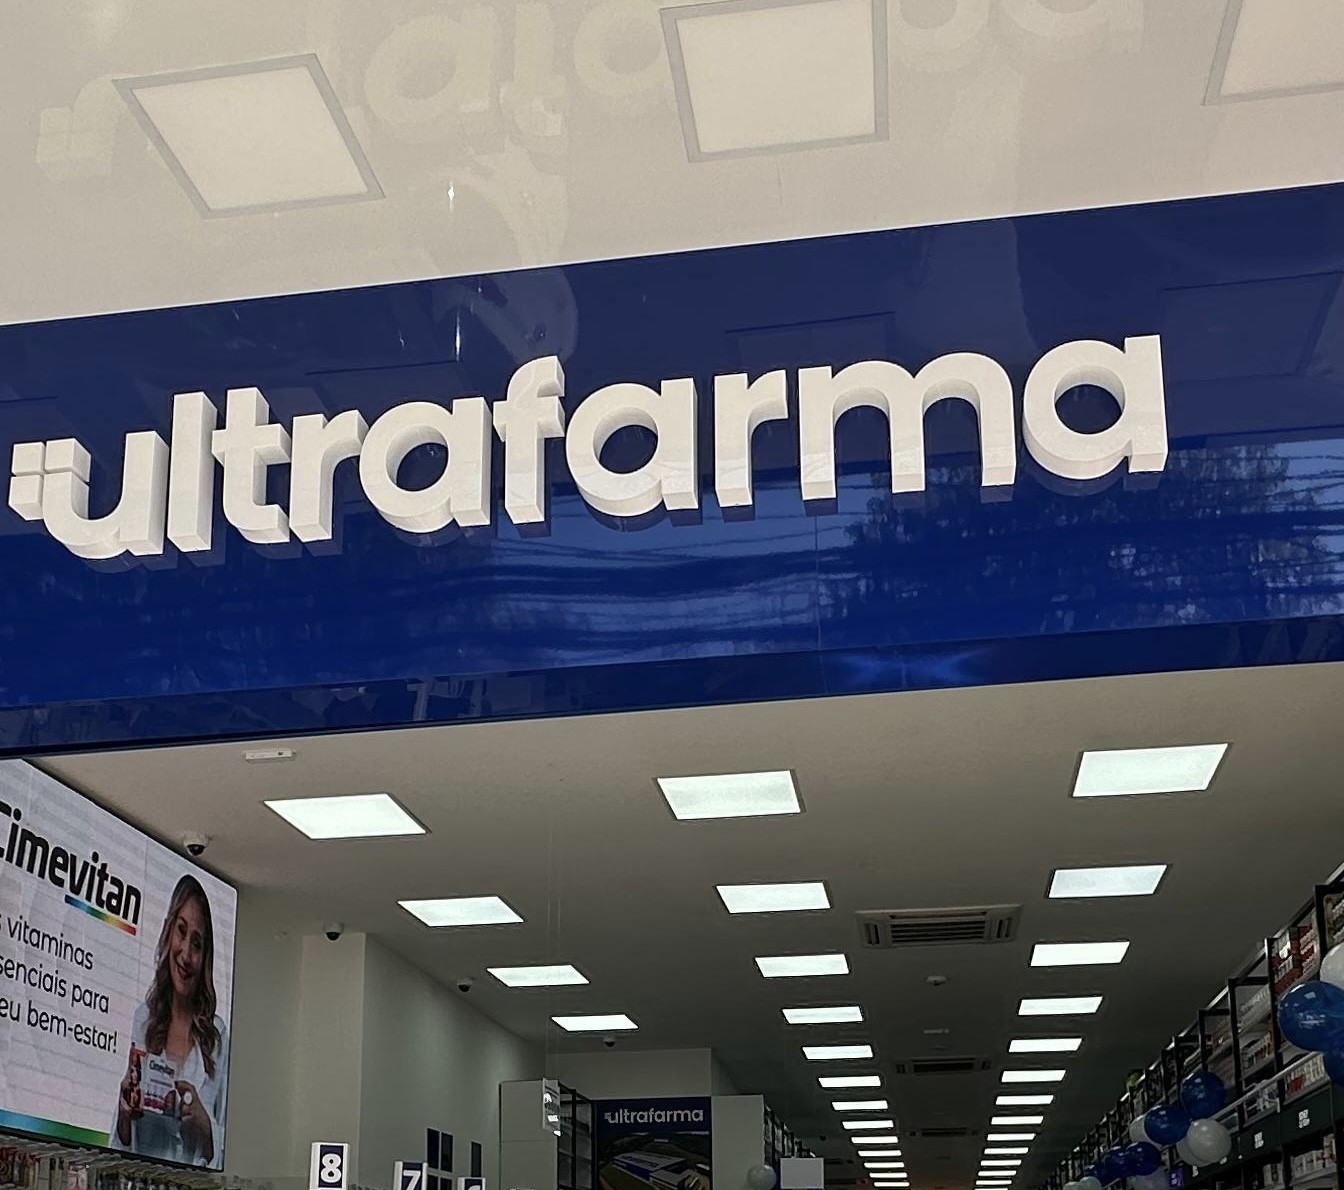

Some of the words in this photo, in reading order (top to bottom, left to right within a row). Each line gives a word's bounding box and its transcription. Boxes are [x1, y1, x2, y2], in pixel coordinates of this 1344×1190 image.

[9, 334, 1168, 558] ultrafarma
[7, 914, 94, 970] vitaminas
[71, 982, 110, 1014] para
[27, 1001, 118, 1053] bem-estar!
[604, 1107, 704, 1124] ultrafarma
[320, 1153, 342, 1183] 8
